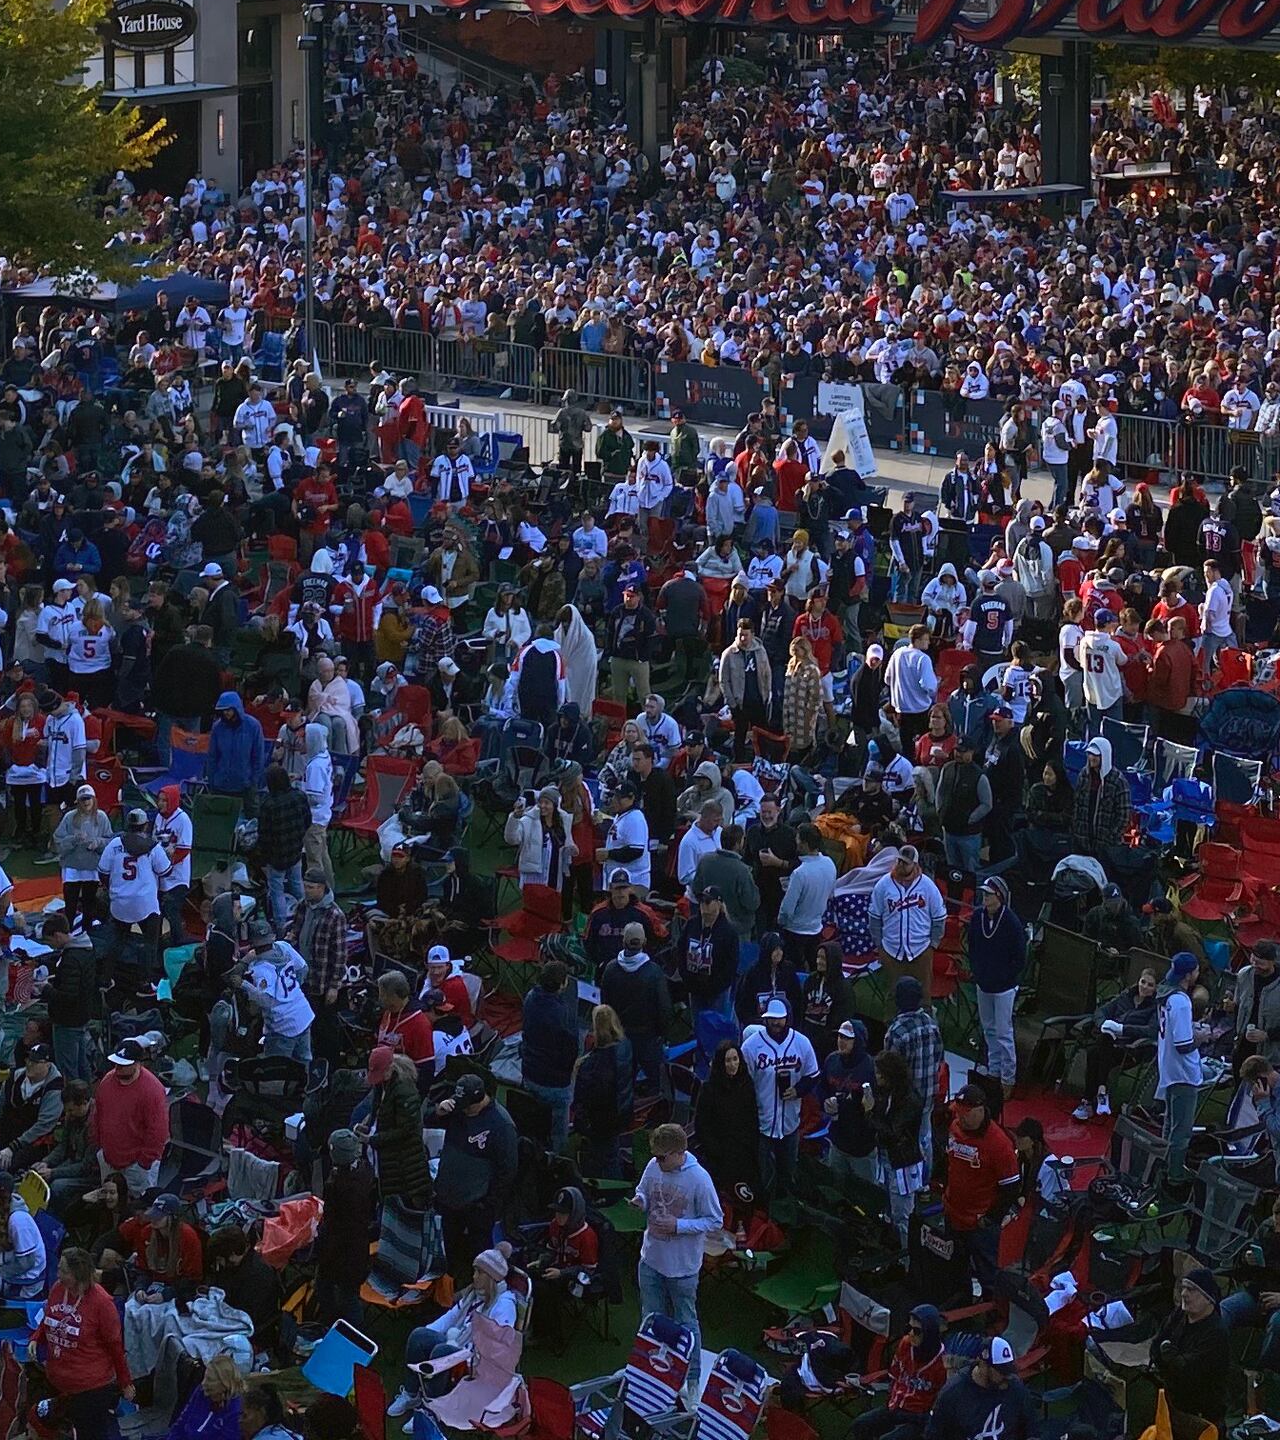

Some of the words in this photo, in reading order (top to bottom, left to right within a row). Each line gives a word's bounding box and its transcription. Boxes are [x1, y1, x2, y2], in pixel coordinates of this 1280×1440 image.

[118, 15, 145, 34] Yard
[147, 13, 183, 32] House
[702, 381, 719, 390] THE
[963, 415, 980, 425] THE
[1205, 532, 1222, 553] 13
[302, 577, 329, 589] FREEMAN
[980, 600, 1006, 612] FREEMAN
[986, 611, 999, 630] 5
[83, 639, 97, 659] 5
[1086, 654, 1104, 673] 13
[121, 856, 137, 881] 5
[888, 894, 924, 912] Braves
[758, 1053, 802, 1070] Braves
